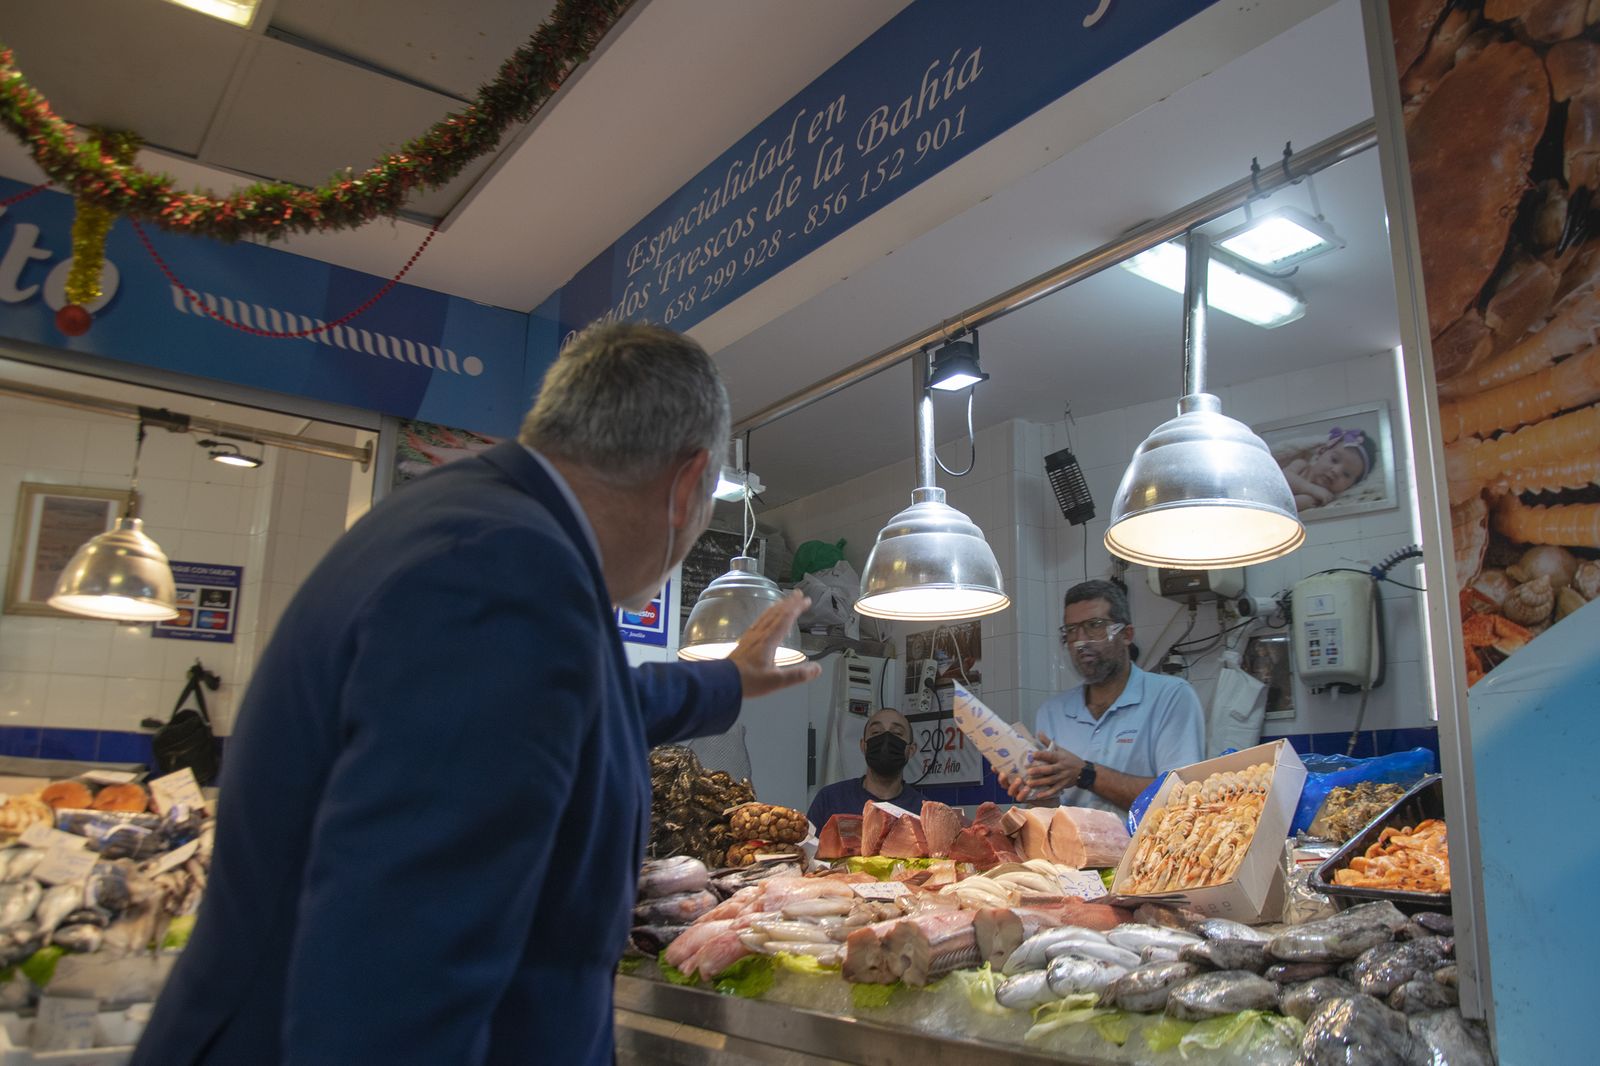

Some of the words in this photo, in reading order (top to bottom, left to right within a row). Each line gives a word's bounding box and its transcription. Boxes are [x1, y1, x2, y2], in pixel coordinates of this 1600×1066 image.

[626, 108, 806, 278] Especialidad
[807, 94, 847, 144] en
[658, 207, 759, 295] Frescos
[765, 164, 803, 223] de
[812, 136, 846, 190] la
[856, 46, 984, 157] Bahía
[664, 286, 697, 324] 658
[700, 259, 737, 302] 299
[742, 229, 783, 276] 928
[803, 182, 851, 235] 856
[856, 147, 905, 202] 152
[913, 105, 967, 166] 901
[920, 726, 965, 752] 2021
